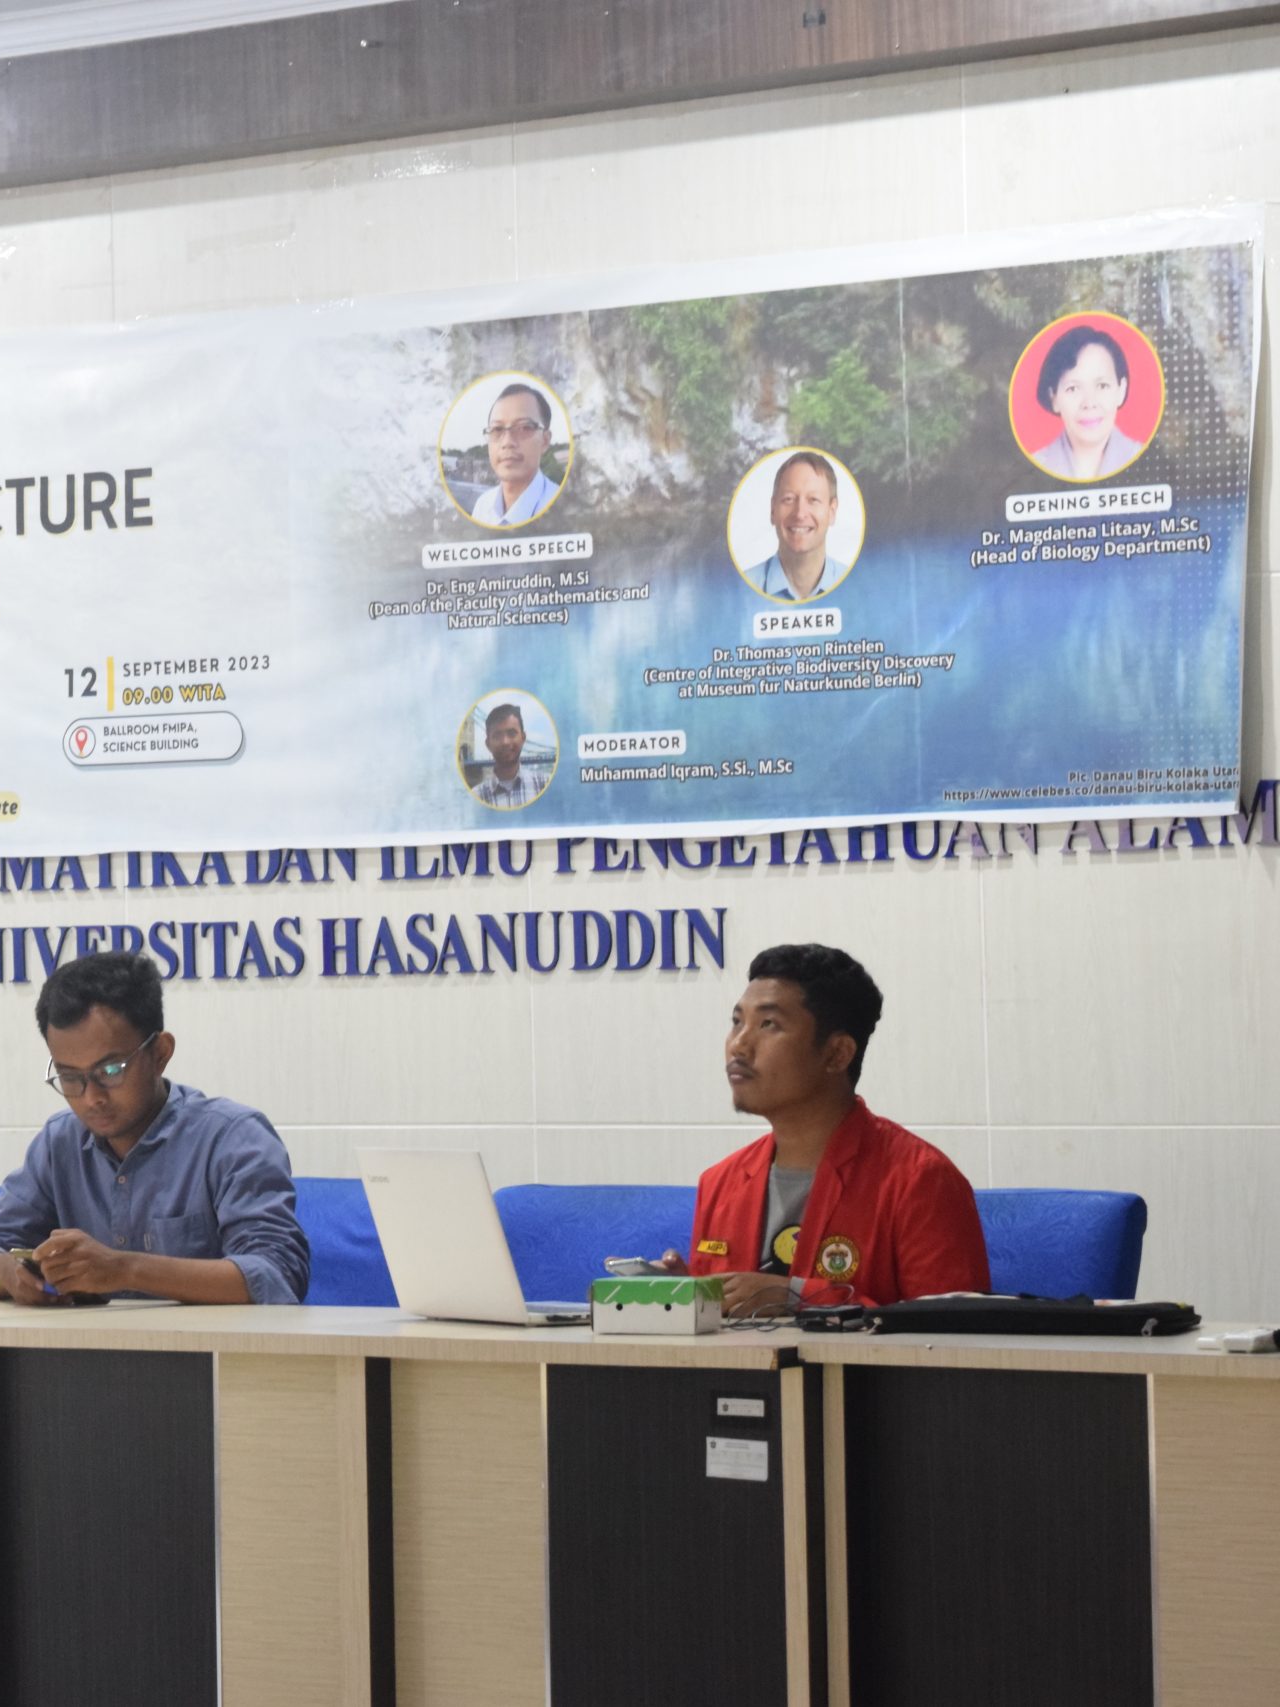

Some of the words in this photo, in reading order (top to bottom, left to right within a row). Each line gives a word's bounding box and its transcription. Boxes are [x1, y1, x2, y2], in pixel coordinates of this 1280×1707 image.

[1012, 496, 1091, 515] OPENING
[1098, 490, 1165, 508] SPEECH
[982, 531, 1005, 546] Dr.
[1009, 524, 1097, 547] Magdalena
[1101, 522, 1156, 538] Litaay,
[1160, 517, 1199, 534] M.Sc
[428, 544, 522, 563] WELCOMING
[528, 539, 587, 556] SPEECH
[970, 548, 1017, 568] (Head
[1021, 546, 1038, 563] of
[1041, 544, 1100, 562] Biology
[1104, 535, 1211, 559] Department)
[426, 582, 448, 596] Dr.
[450, 580, 476, 597] Eng
[478, 574, 556, 593] Amiruddin,
[559, 570, 589, 586] M.Si
[369, 602, 409, 620] (Dean
[411, 600, 428, 615] of
[428, 598, 453, 613] the
[455, 596, 507, 614] Faculty
[509, 594, 526, 609] of
[527, 587, 619, 608] Mathematics
[622, 584, 649, 600] and
[448, 612, 501, 630] Natural
[503, 608, 569, 626] Sciences)
[759, 614, 835, 631] SPEAKER
[712, 648, 734, 662] Dr.
[736, 645, 792, 661] Thomas
[795, 646, 821, 658] von
[824, 639, 884, 656] Rintelen
[64, 667, 98, 698] 12
[123, 658, 220, 677] SEPTEMBER
[228, 655, 270, 672] 2023
[643, 667, 695, 685] (Centre
[698, 665, 714, 681] of
[715, 661, 793, 682] Integrative
[796, 656, 881, 676] Biodiversity
[884, 653, 955, 671] Discovery
[122, 686, 174, 705] 09.00
[179, 683, 227, 702] WITA
[678, 685, 693, 698] at
[696, 682, 756, 698] Museum
[783, 675, 871, 693] Naturkunde
[874, 671, 922, 689] Berlin)
[103, 723, 160, 737] BALLROOM
[163, 722, 197, 734] FMIPA,
[103, 741, 147, 753] SCIENCE
[150, 738, 199, 751] BUILDING
[584, 736, 680, 752] MODERATOR
[581, 763, 667, 783] Muhammad
[670, 764, 719, 782] Iqram,
[758, 758, 793, 775] M.Sc
[1093, 769, 1133, 782] Danau
[1137, 768, 1163, 781] Biru
[1166, 767, 1209, 780] Kolaka
[317, 907, 728, 977] HASANUDDIN
